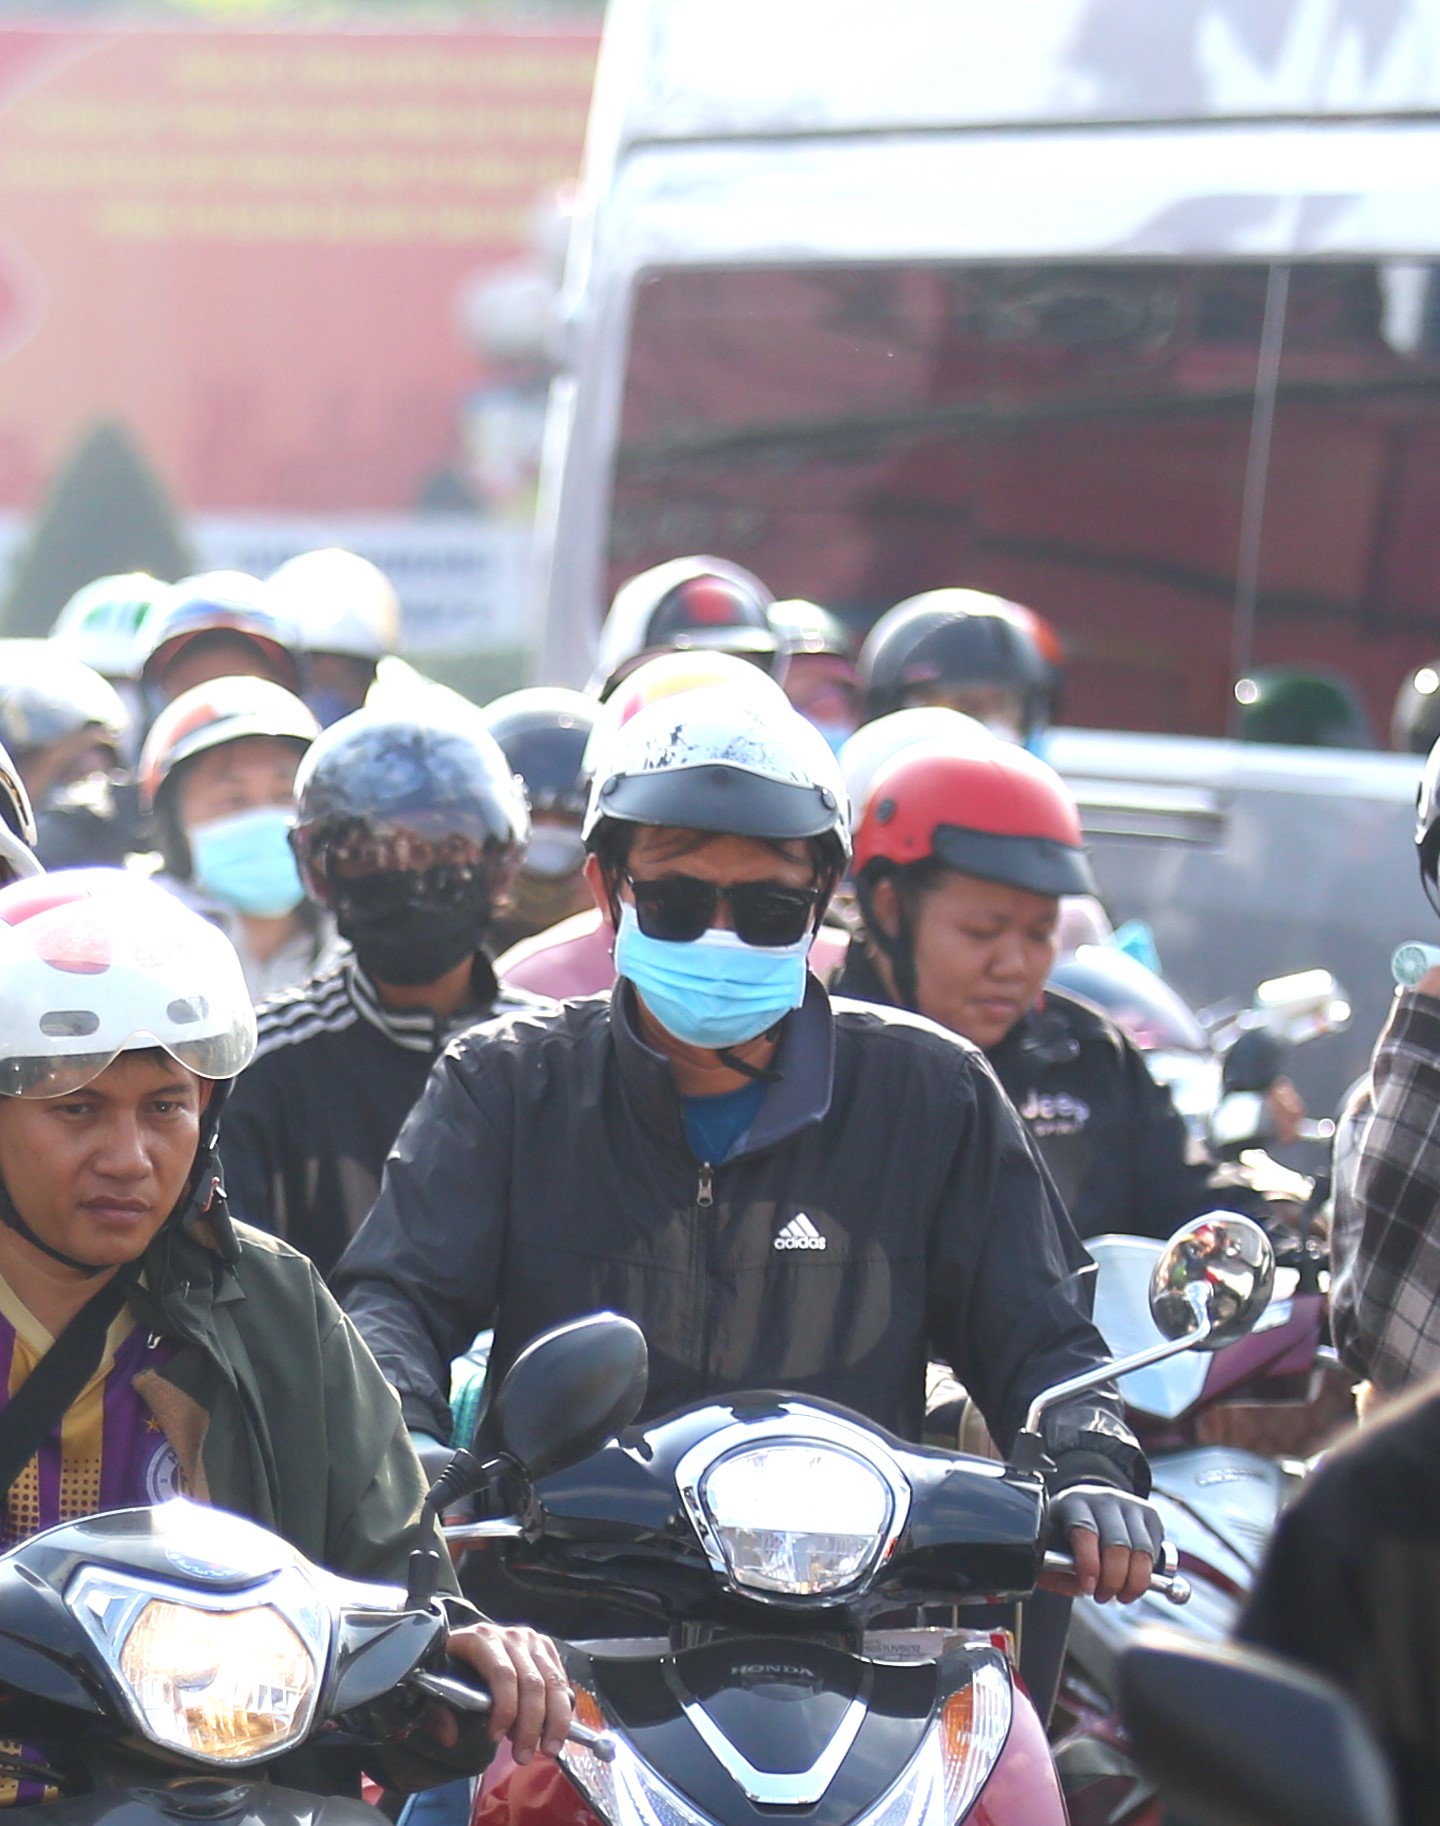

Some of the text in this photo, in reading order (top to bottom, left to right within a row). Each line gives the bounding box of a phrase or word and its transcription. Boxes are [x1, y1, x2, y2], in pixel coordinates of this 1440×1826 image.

[1021, 1087, 1091, 1128] Jeep
[774, 1235, 826, 1250] adidas
[731, 1664, 815, 1677] HONDA
